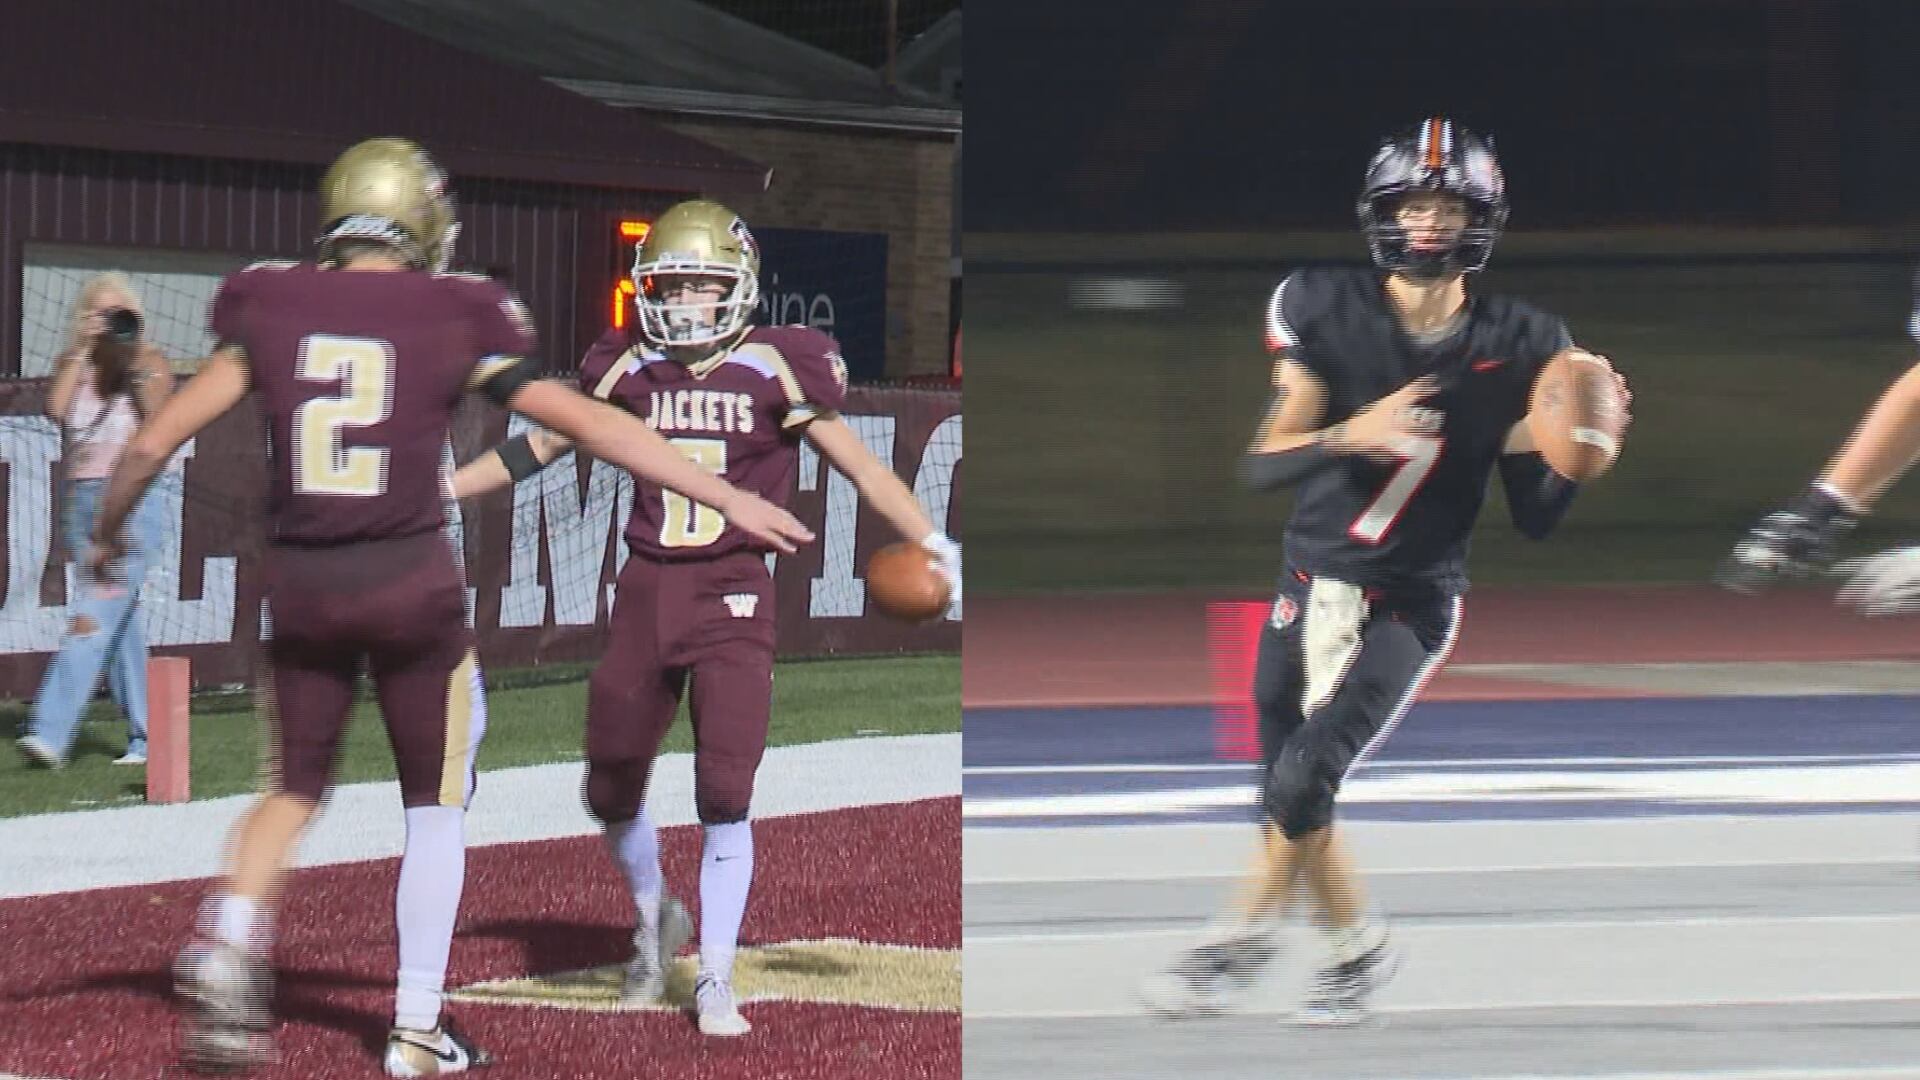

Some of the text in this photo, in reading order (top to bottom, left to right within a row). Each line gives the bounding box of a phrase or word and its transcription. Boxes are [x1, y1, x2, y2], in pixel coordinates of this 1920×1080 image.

[292, 333, 396, 496] 2
[645, 389, 755, 433] JACKETS
[1348, 437, 1448, 545] 7
